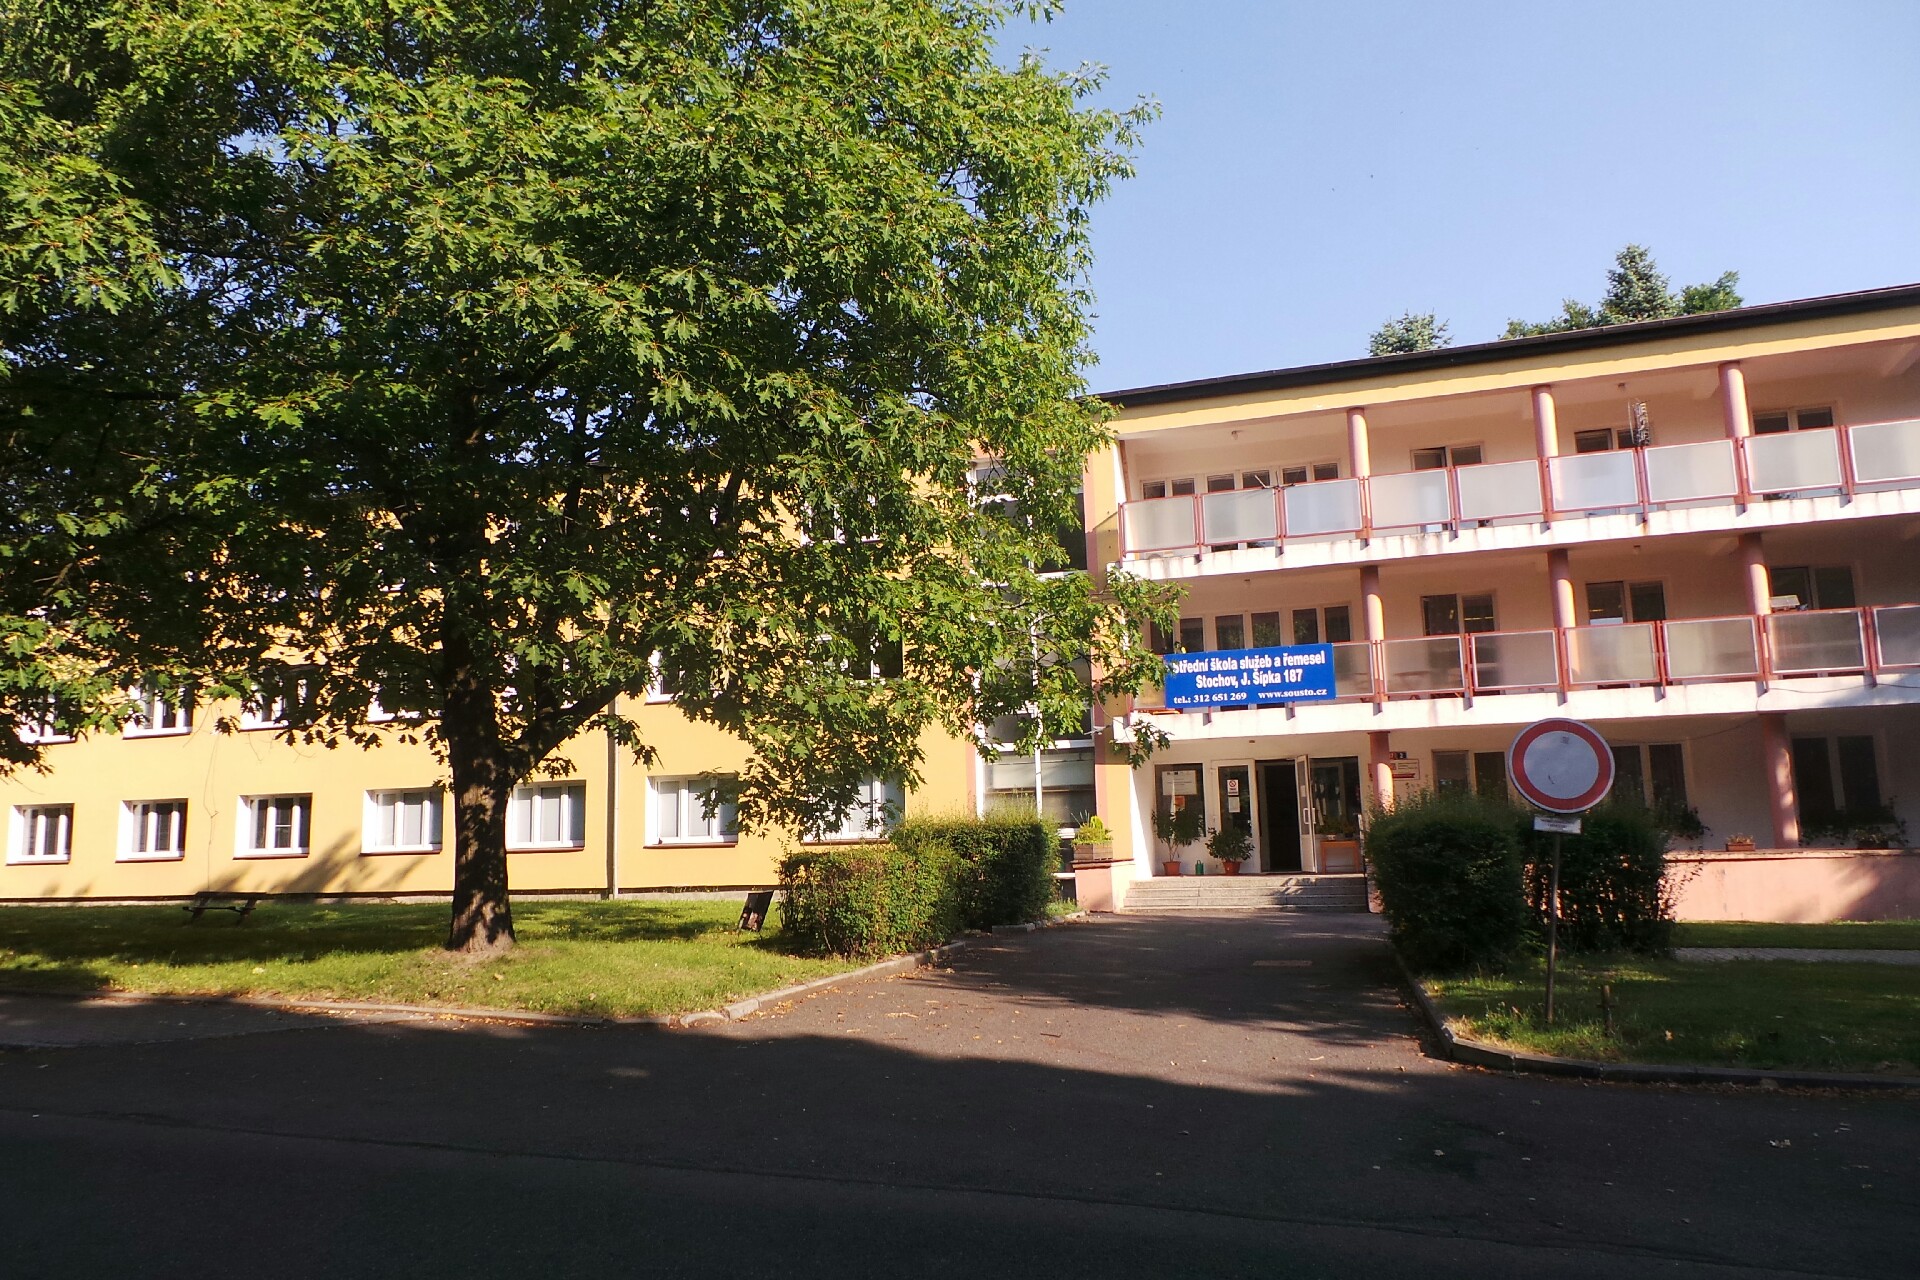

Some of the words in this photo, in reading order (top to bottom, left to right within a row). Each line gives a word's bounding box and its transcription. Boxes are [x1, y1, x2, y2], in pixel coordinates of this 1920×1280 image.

[1172, 658, 1208, 674] Střední
[1210, 657, 1238, 671] škola
[1240, 654, 1272, 670] služeb
[1274, 656, 1281, 667] a
[1283, 650, 1325, 666] řemesel
[1196, 674, 1238, 689] Stochov,
[1241, 672, 1251, 686] J.
[1252, 668, 1281, 687] Šípka
[1284, 668, 1303, 683] 187
[1173, 695, 1191, 704] tel.:
[1193, 694, 1210, 703] 312
[1212, 693, 1228, 701] 651
[1230, 692, 1247, 700] 269
[1258, 689, 1327, 699] www.sousto.cz
